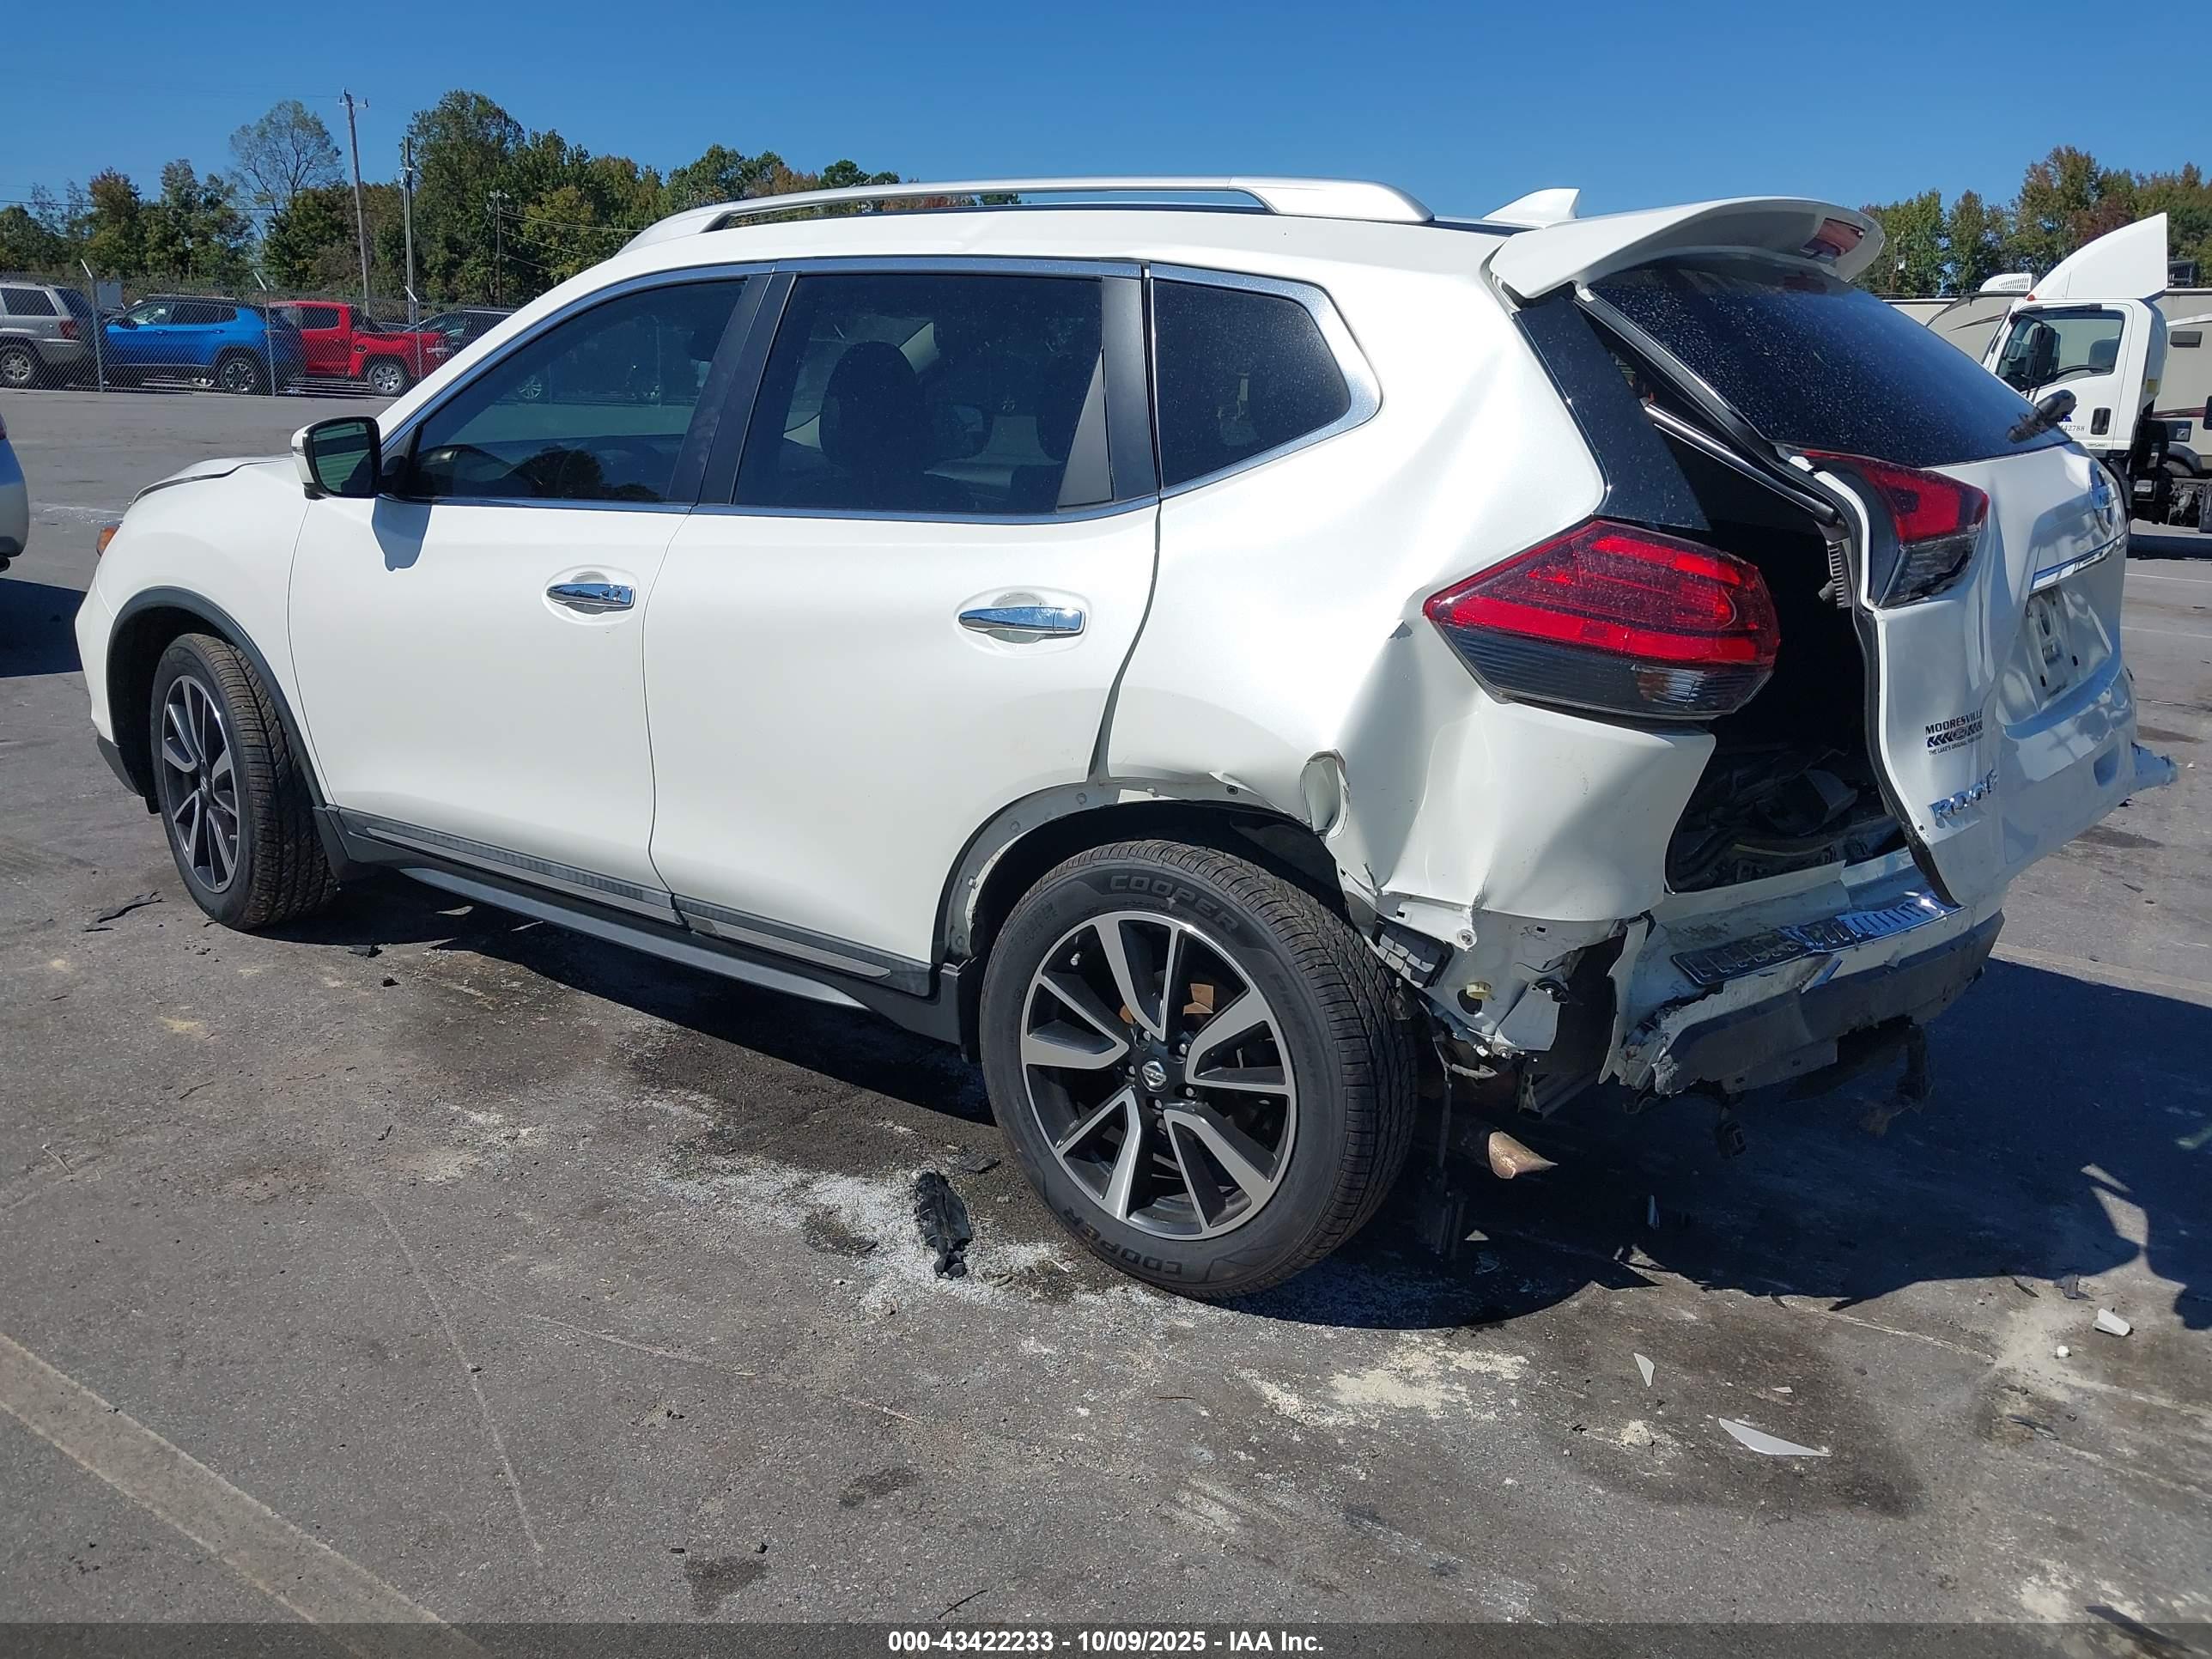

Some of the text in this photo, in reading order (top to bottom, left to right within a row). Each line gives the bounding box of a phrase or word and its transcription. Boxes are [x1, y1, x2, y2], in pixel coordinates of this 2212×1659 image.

[1925, 708, 1983, 735] MOORESVILLE
[1109, 874, 1240, 933] COOPER
[1063, 1206, 1183, 1275] COOPER
